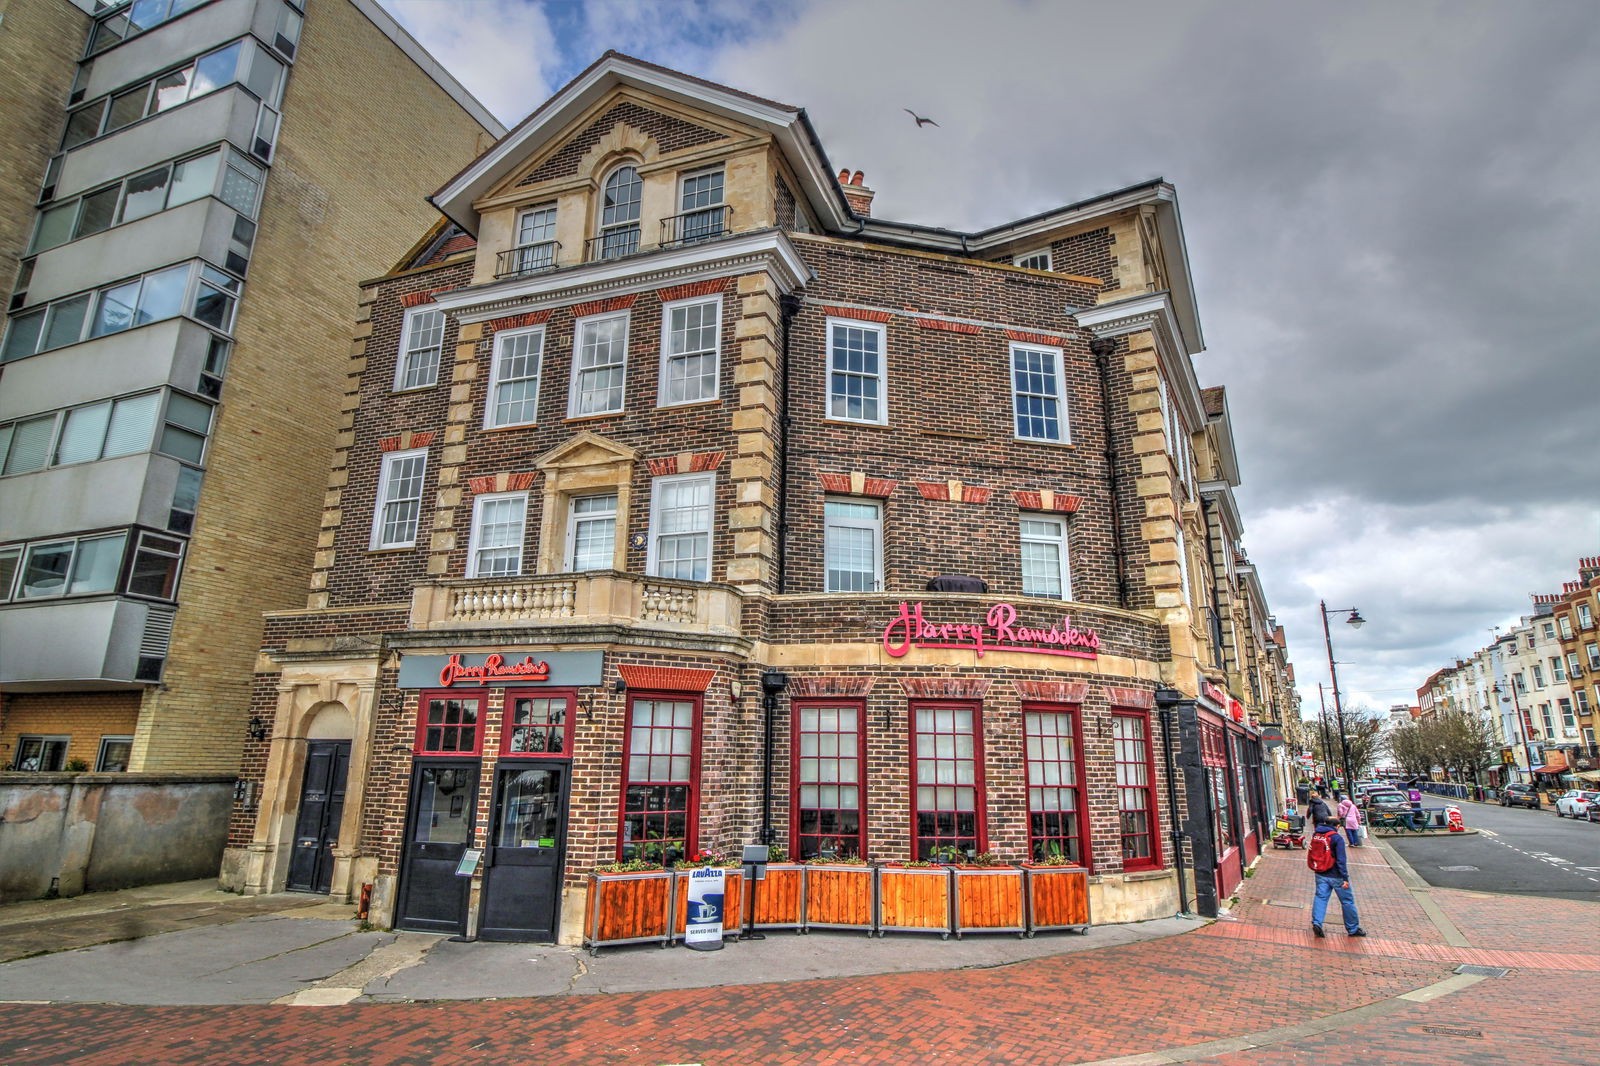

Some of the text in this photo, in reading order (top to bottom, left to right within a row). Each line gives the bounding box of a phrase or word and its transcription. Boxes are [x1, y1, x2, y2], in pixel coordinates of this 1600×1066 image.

[883, 601, 1100, 659] Harry Ramsden's
[439, 653, 550, 687] Harry Ramsden's
[692, 868, 723, 878] LAVAZZA
